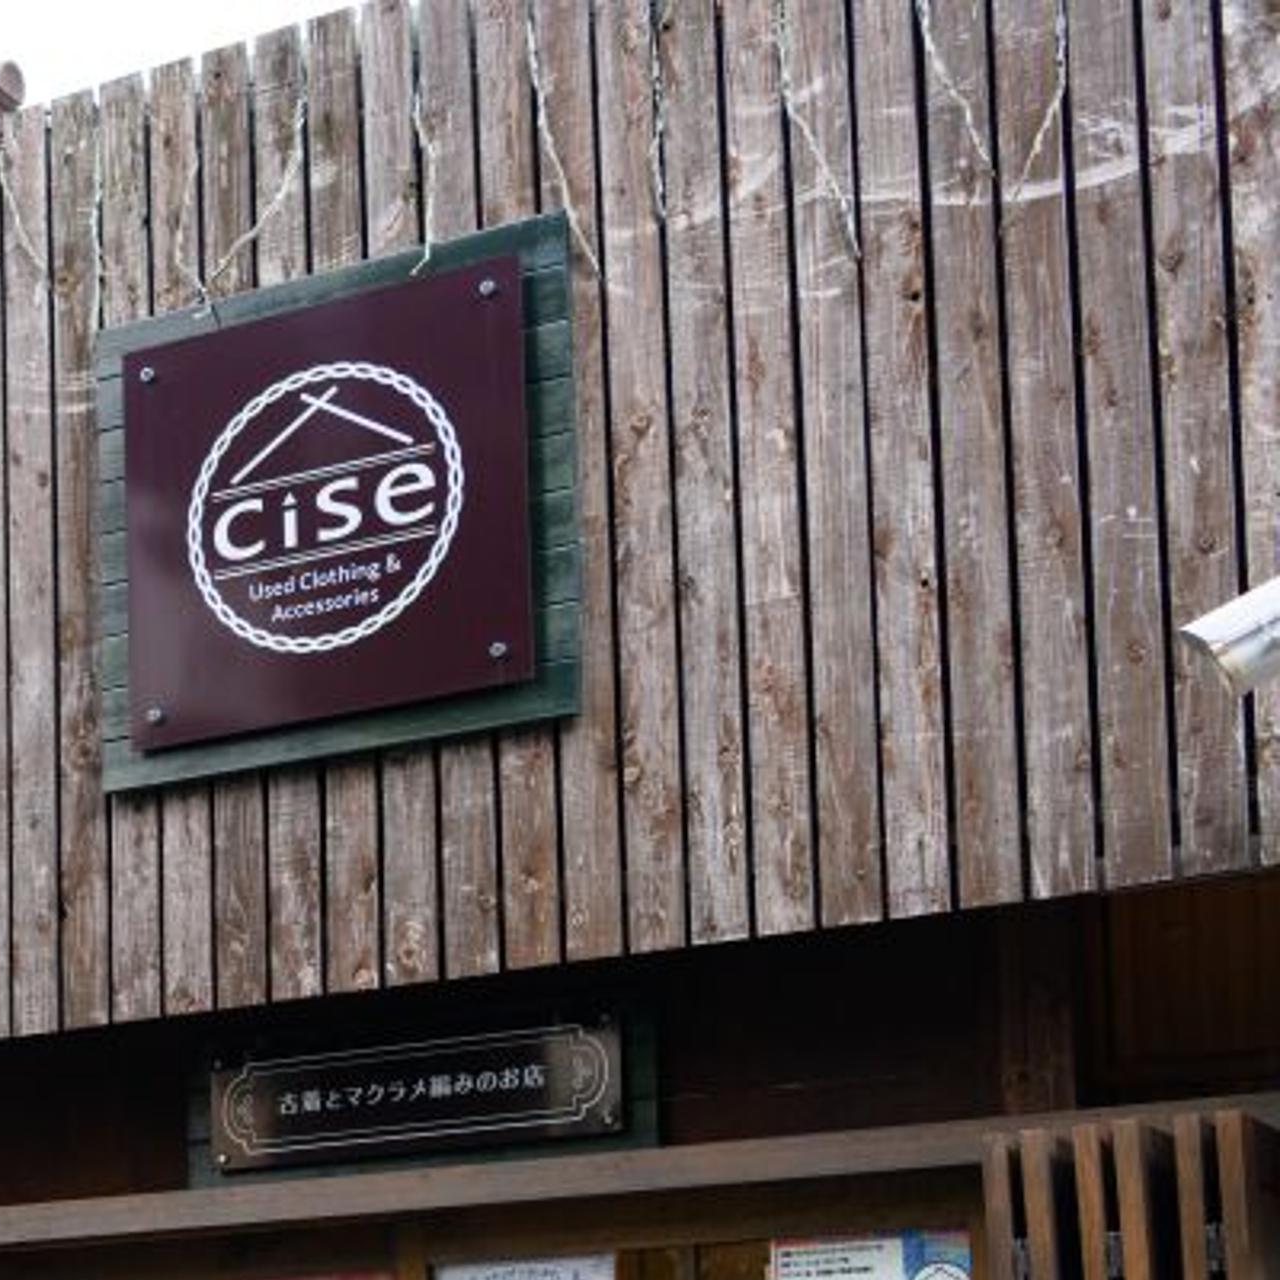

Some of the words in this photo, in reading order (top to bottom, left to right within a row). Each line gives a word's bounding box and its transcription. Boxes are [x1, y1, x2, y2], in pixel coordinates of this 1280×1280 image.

[248, 575, 296, 602] Used
[299, 562, 382, 592] Clothing
[384, 553, 402, 573] &
[271, 587, 380, 622] Accessories
[278, 1064, 547, 1115] 古着とマクラメ編みのお店
